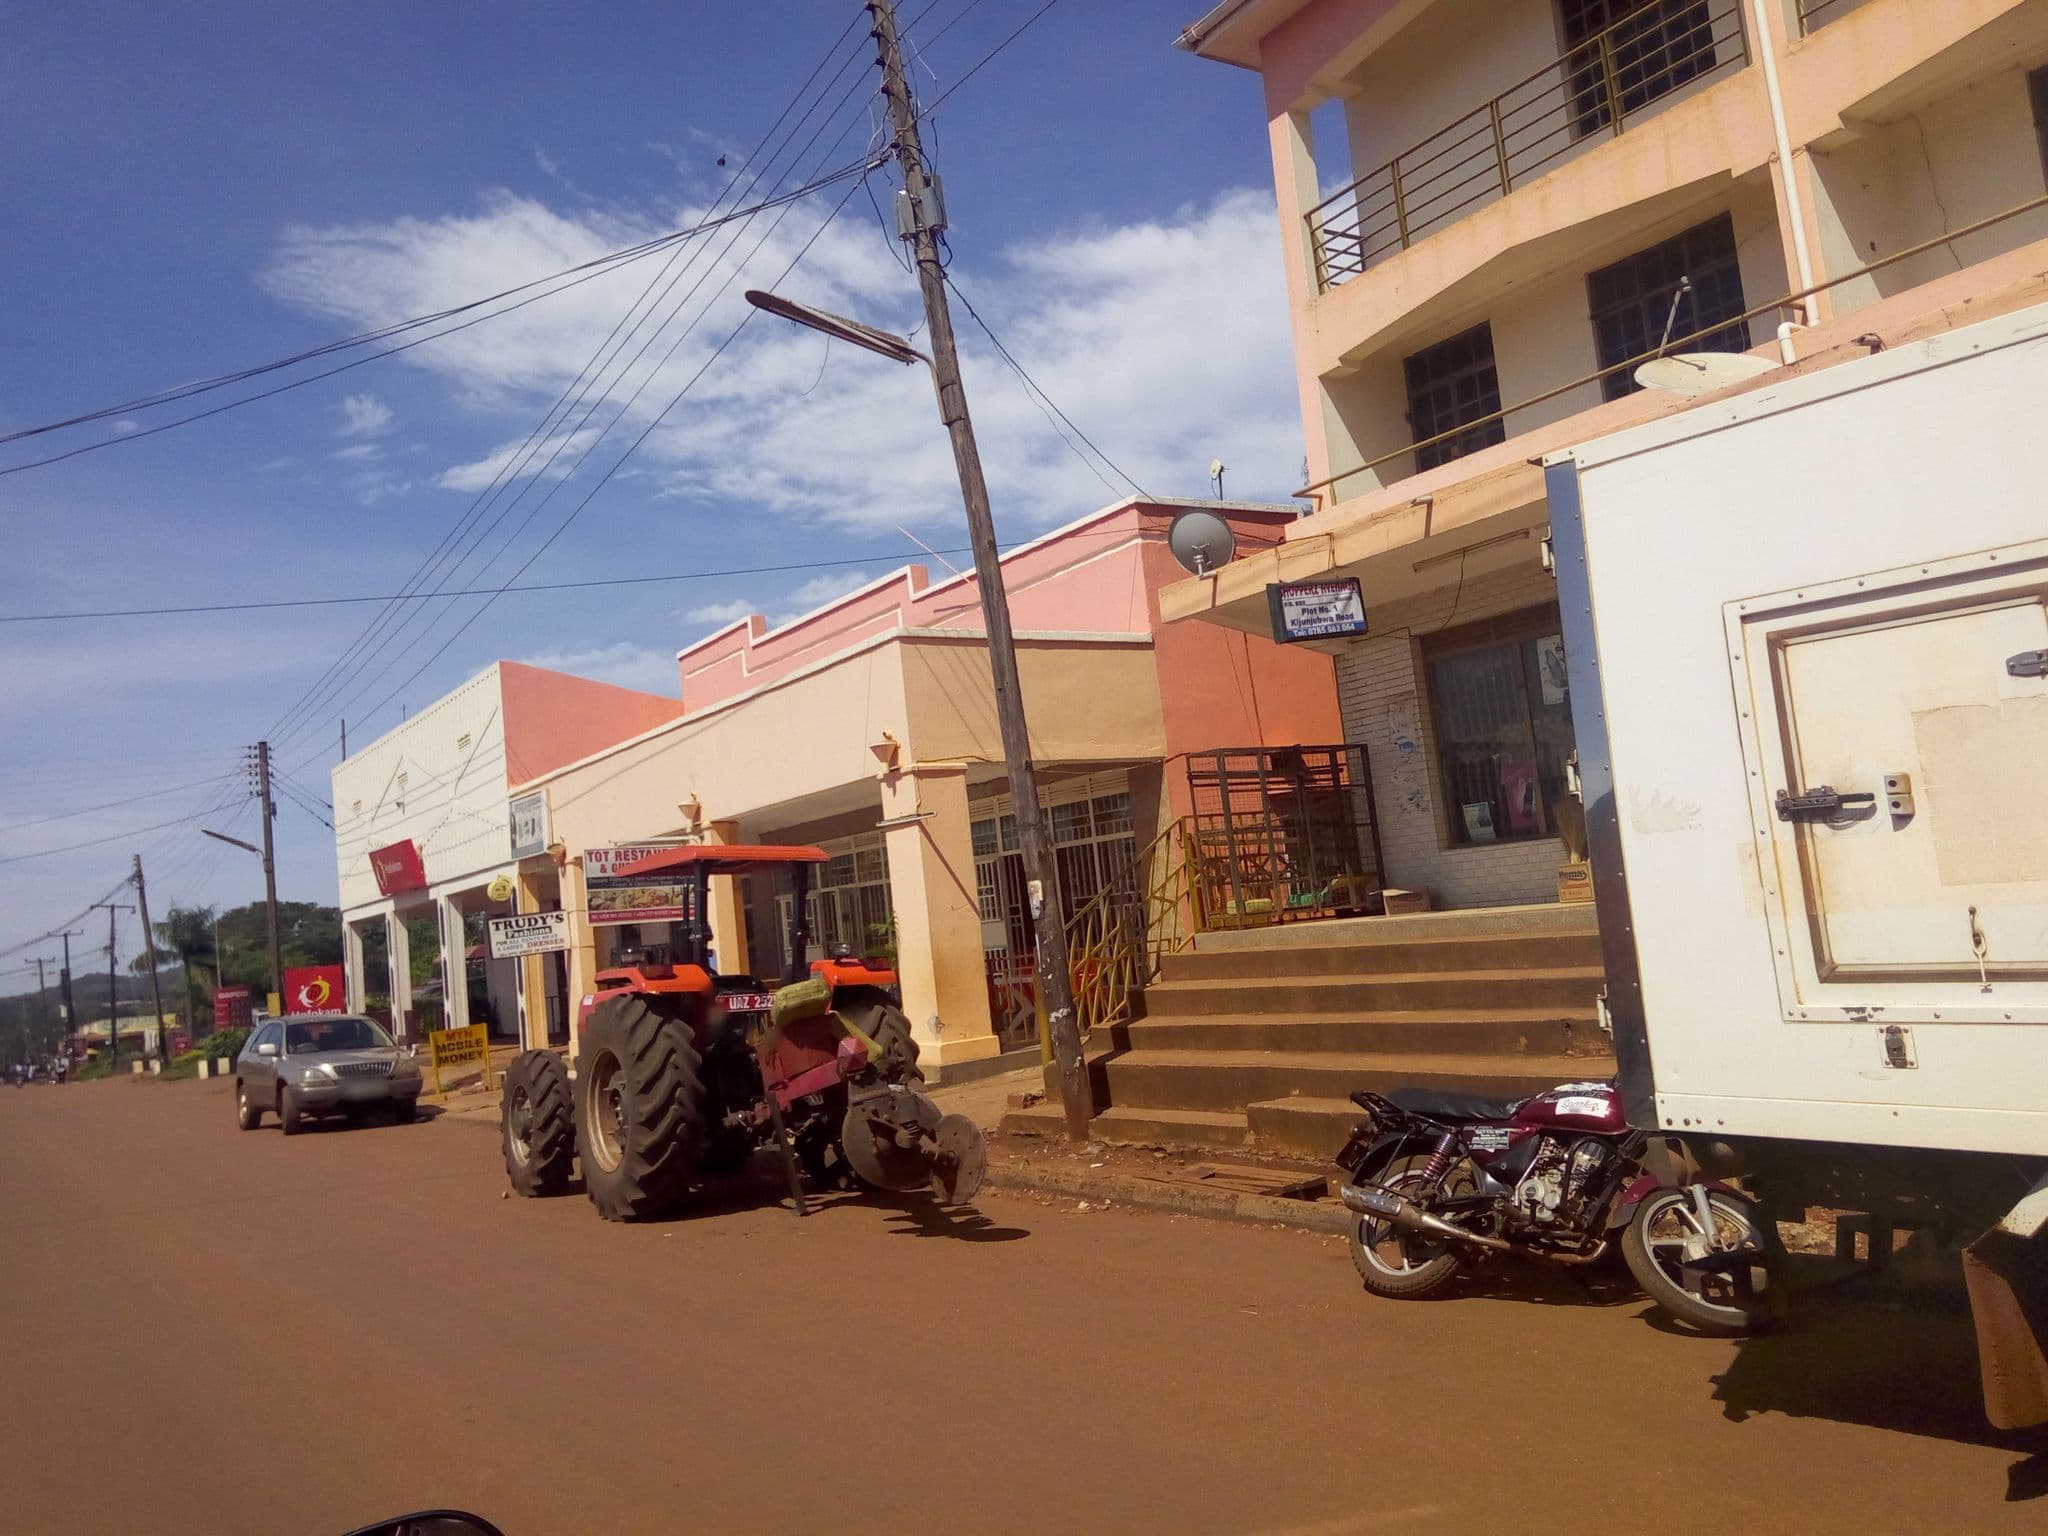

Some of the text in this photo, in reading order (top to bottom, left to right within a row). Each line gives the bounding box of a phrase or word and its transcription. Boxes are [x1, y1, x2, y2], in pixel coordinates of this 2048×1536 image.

[1301, 607, 1317, 616] Plot
[1318, 606, 1331, 614] No.
[1335, 613, 1355, 621] Road
[587, 850, 609, 863] TOT
[600, 863, 608, 873] &
[492, 913, 564, 931] TRUDY'S
[507, 926, 551, 938] Fashions
[527, 938, 564, 948] DRESSES
[729, 995, 775, 1009] UAZ 252
[437, 1038, 483, 1053] MOBILE
[440, 1050, 483, 1064] MONEY
